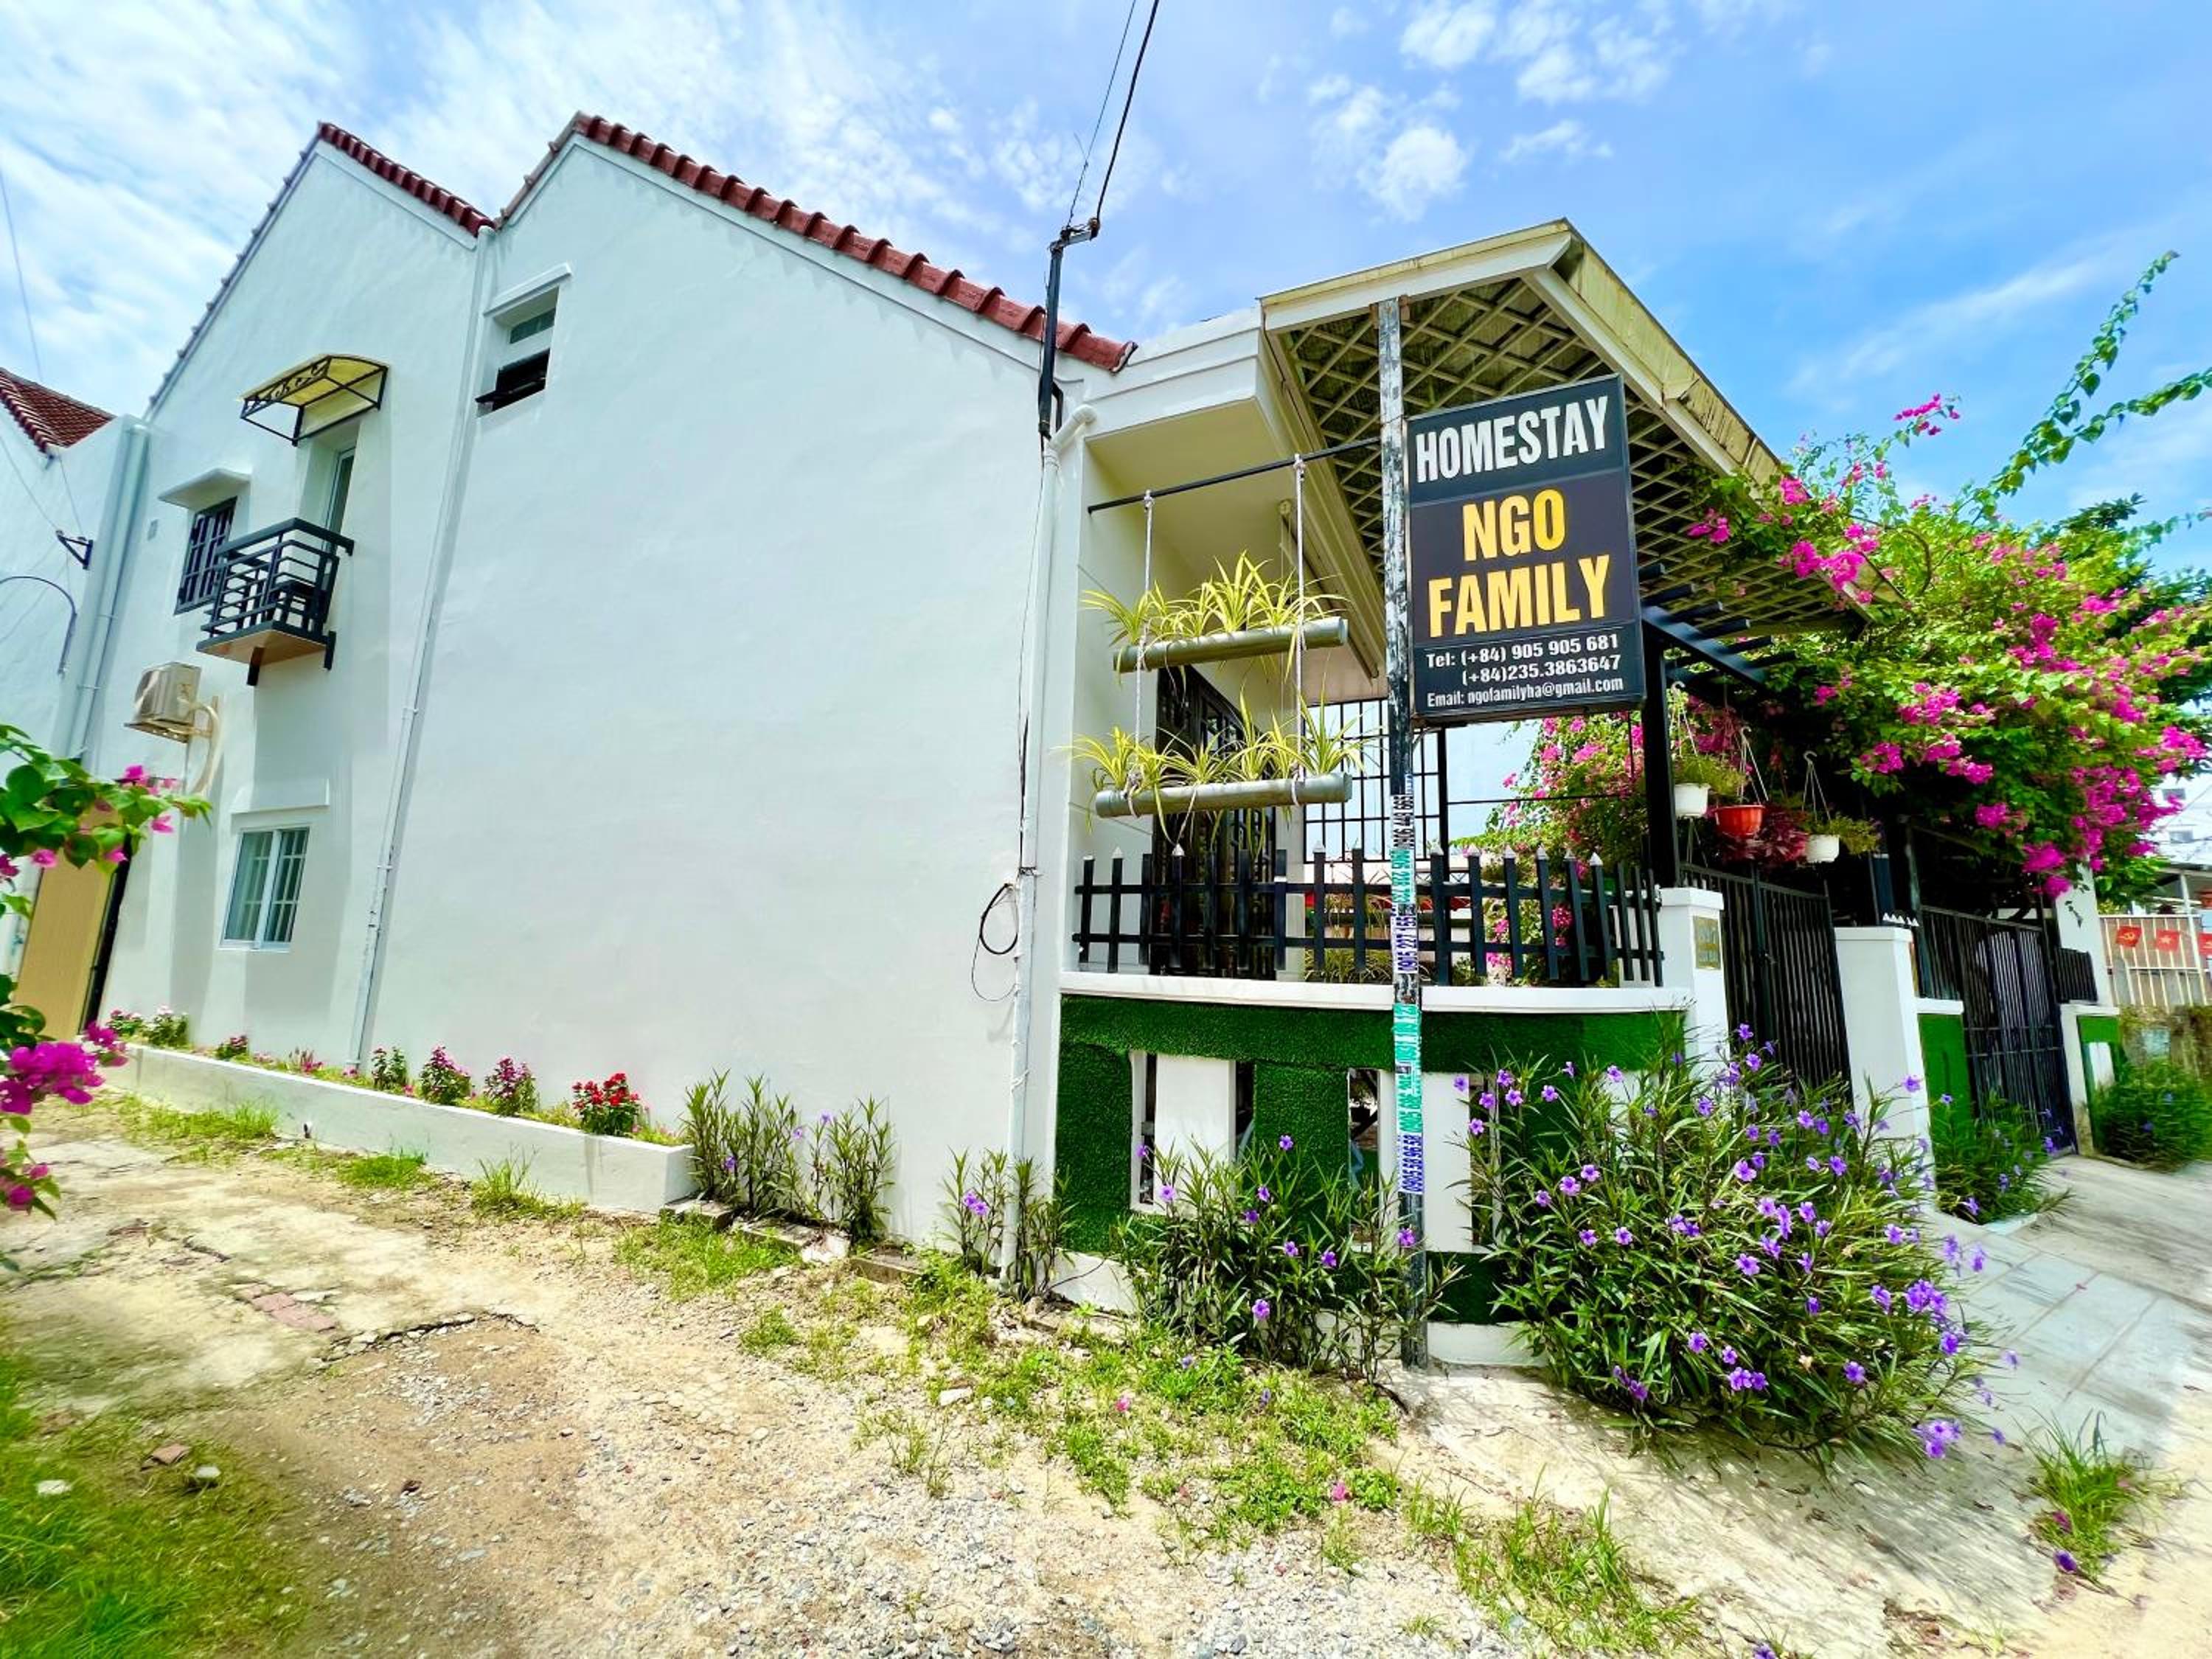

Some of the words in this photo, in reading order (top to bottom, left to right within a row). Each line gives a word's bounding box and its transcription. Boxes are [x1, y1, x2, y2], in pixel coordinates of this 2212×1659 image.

[1416, 396, 1608, 483] HOMESTAY
[1462, 489, 1566, 562] NGO
[1428, 554, 1610, 638] FAMILY
[1426, 653, 1456, 668] Tel:
[1461, 647, 1506, 666] (+84)
[1512, 642, 1543, 659] 905
[1548, 638, 1582, 655] 905
[1586, 633, 1618, 651] 681
[1461, 654, 1621, 686] (+84)235.3863647
[1427, 691, 1465, 708] Email:
[1467, 678, 1624, 705] ngofamilyha@gmail.com
